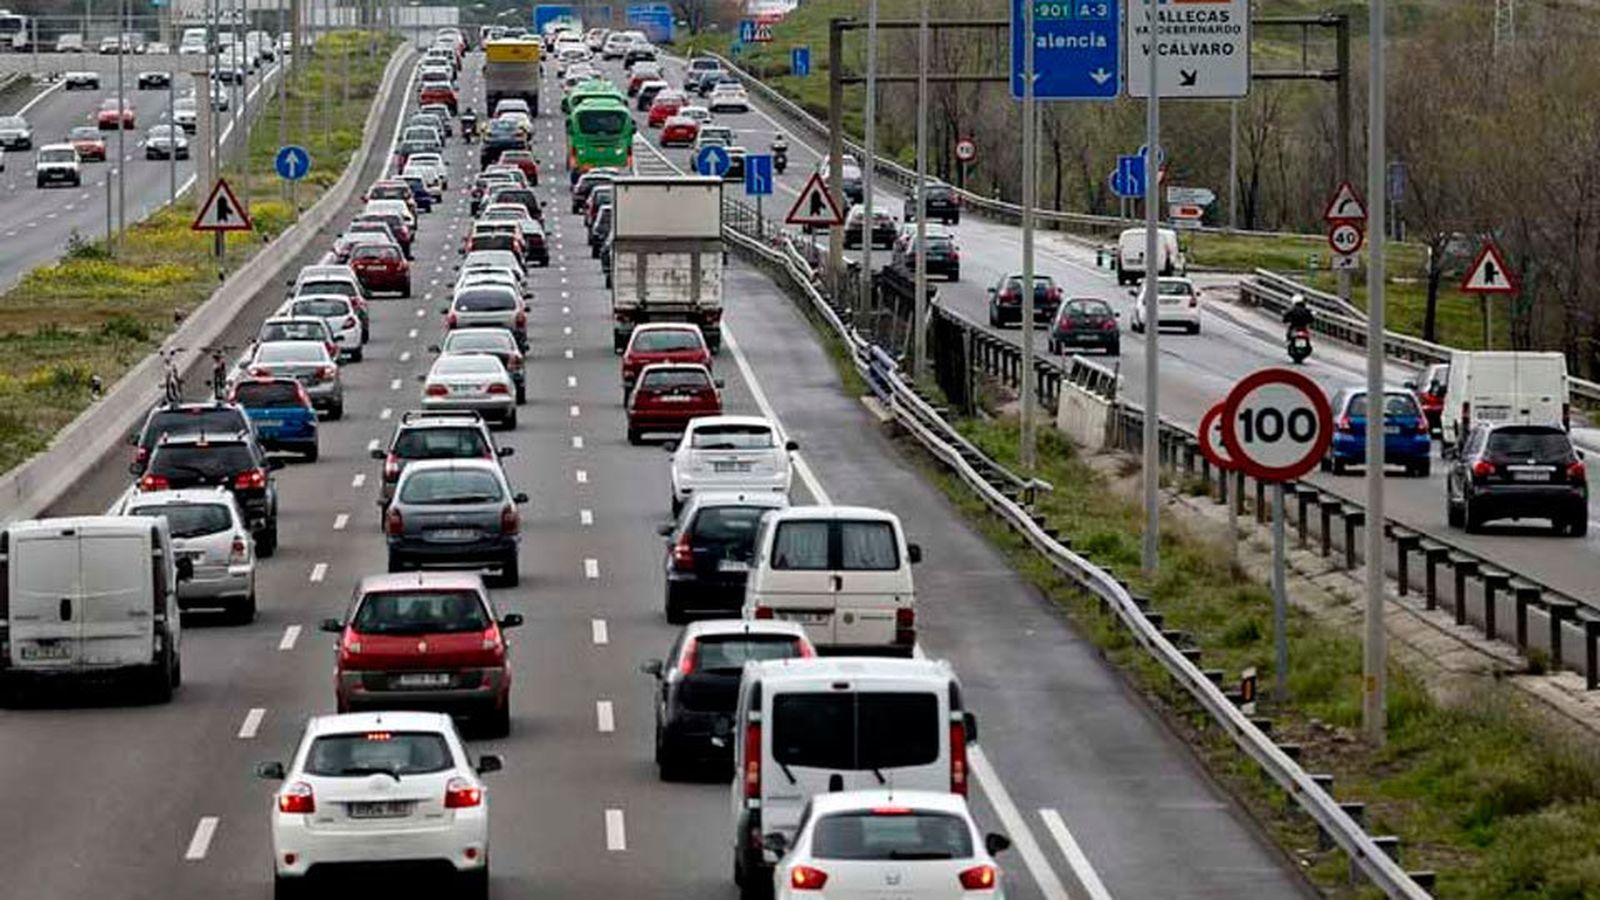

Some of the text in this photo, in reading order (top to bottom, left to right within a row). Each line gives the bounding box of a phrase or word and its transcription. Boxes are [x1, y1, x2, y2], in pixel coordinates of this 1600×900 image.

[1031, 3, 1068, 17] -901
[1135, 24, 1241, 35] VADEBERNARDO
[1033, 31, 1107, 48] alencia
[1336, 232, 1355, 243] 40
[1239, 408, 1316, 442] 100
